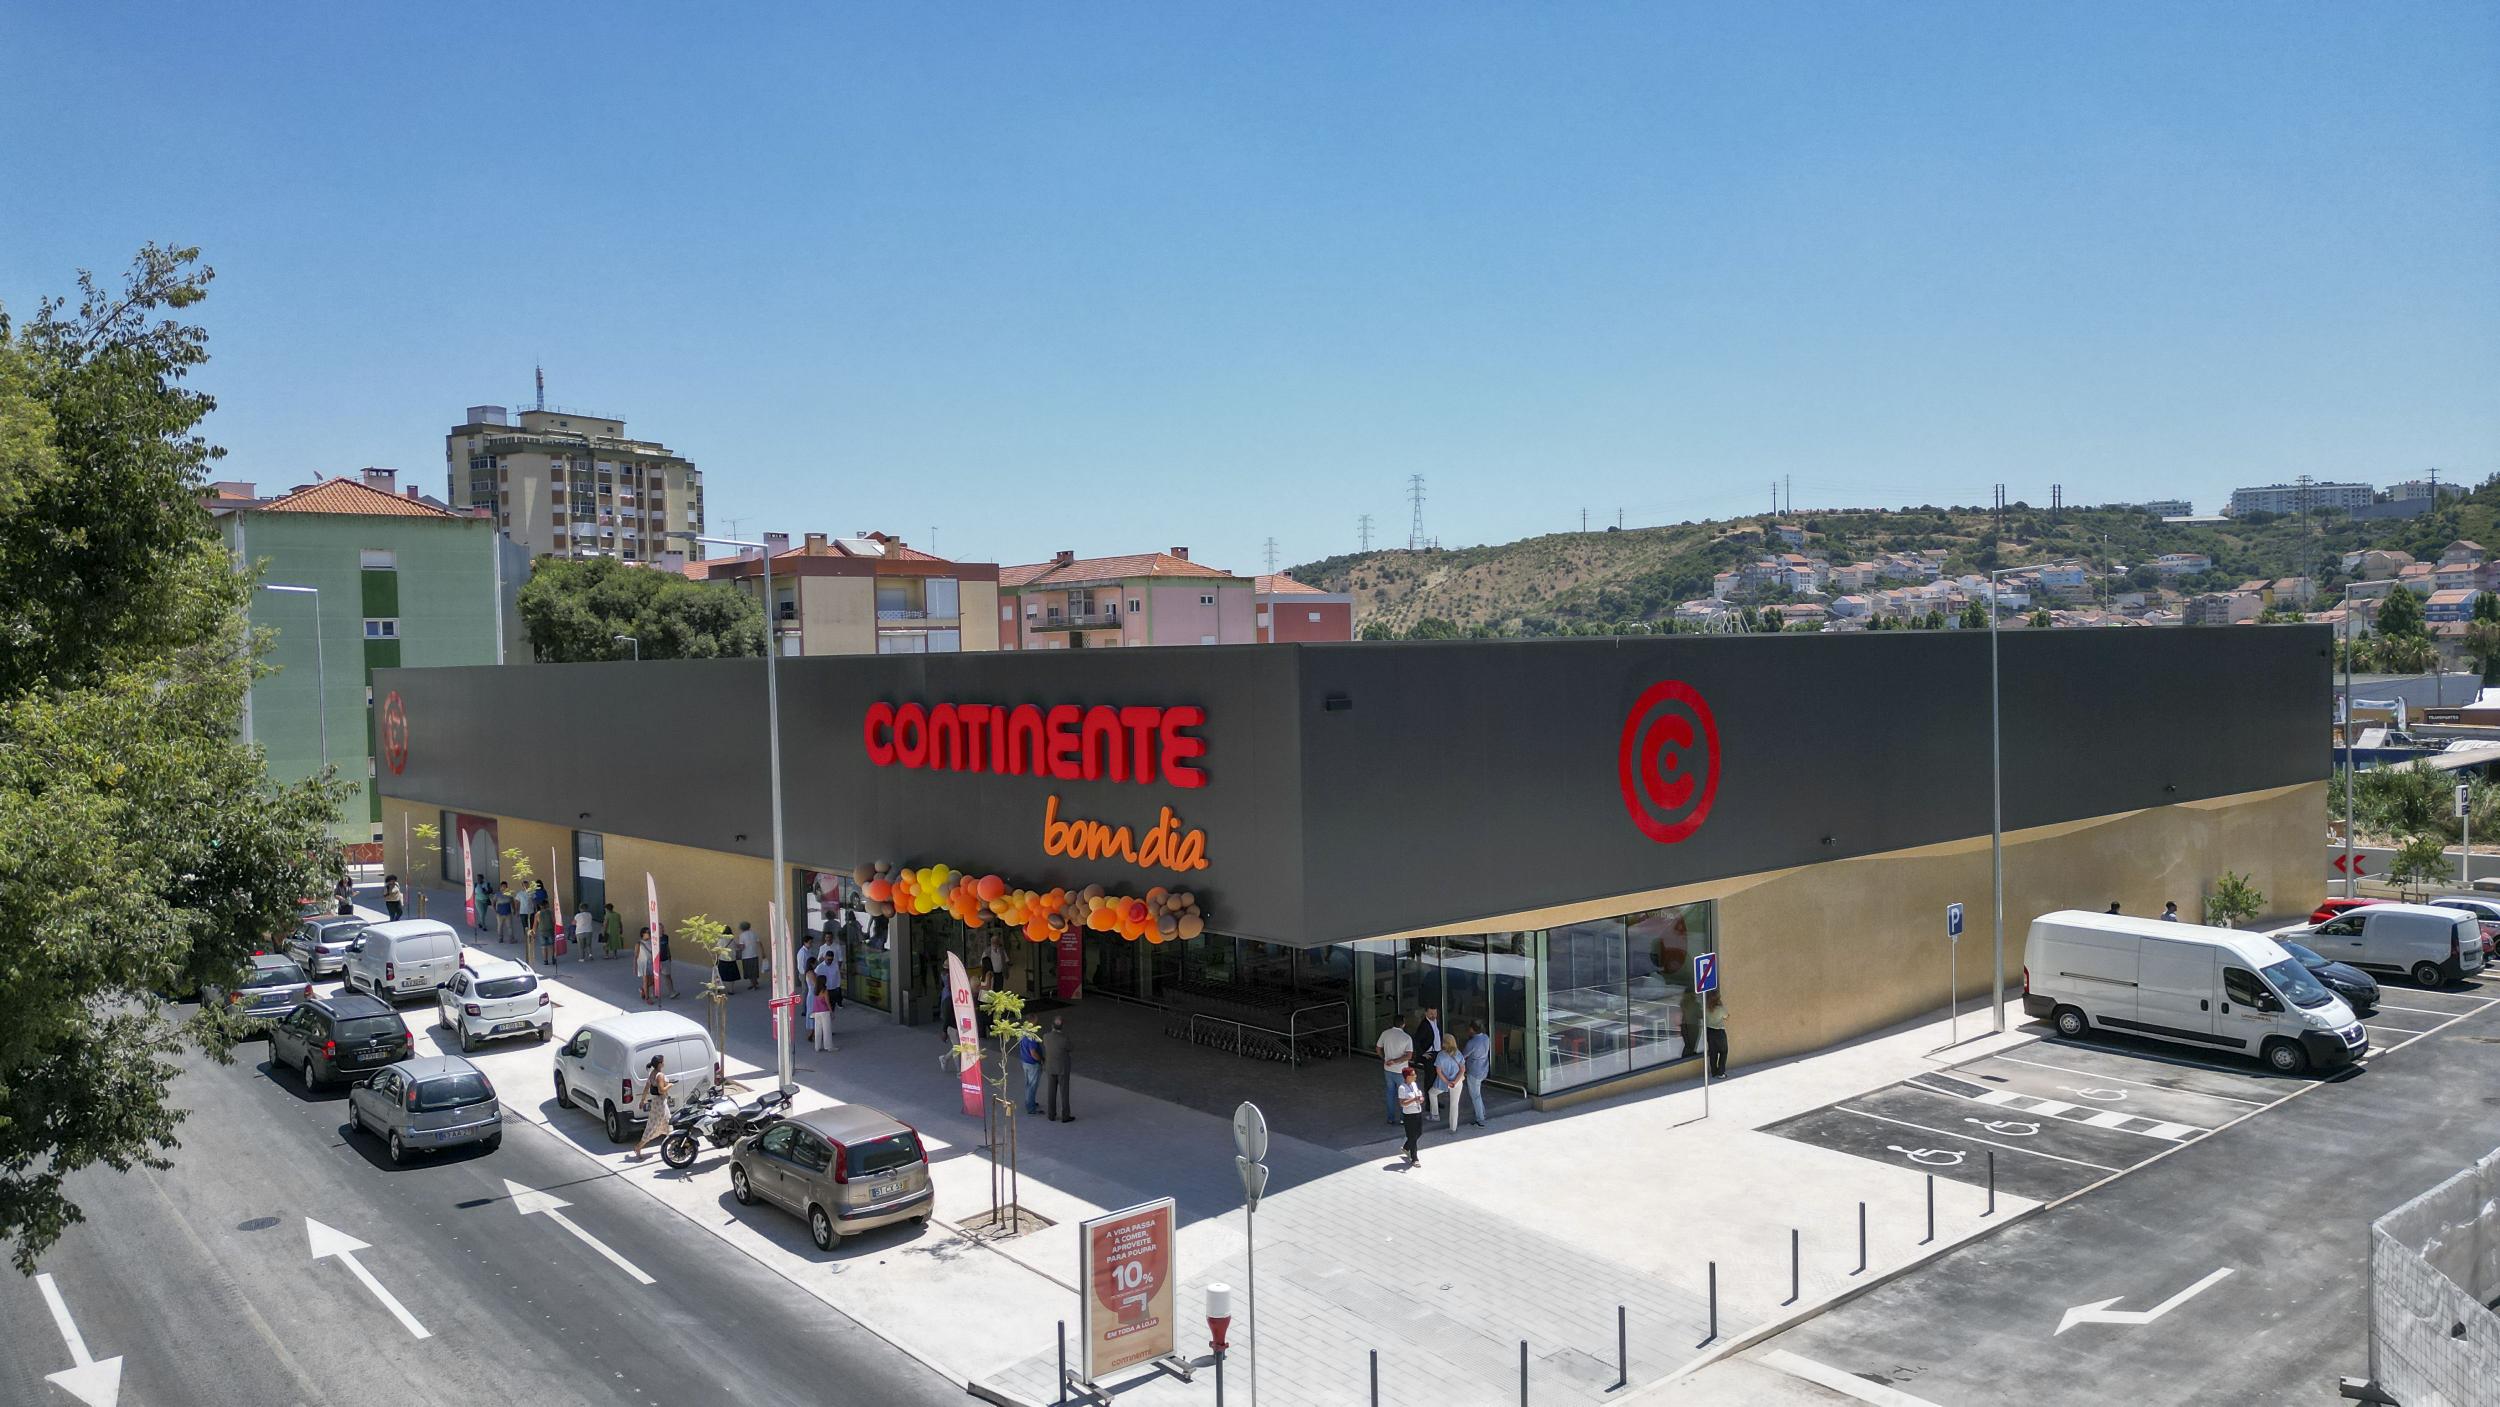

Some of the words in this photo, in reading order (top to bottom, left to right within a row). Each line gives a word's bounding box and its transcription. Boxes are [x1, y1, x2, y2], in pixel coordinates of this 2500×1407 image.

[864, 701, 1208, 789] CONTINENTE
[1043, 794, 1138, 862] bom
[1138, 805, 1212, 872] dia
[1951, 907, 1960, 933] P
[1106, 1231, 1112, 1239] A
[1113, 1226, 1131, 1237] VIDA
[1131, 1219, 1156, 1232] PASSA
[1112, 1238, 1152, 1254] APROVEITE
[1114, 1237, 1120, 1245] A
[1106, 1252, 1127, 1264] PARA
[1127, 1244, 1157, 1258] POUPAR
[1112, 1260, 1153, 1290] 10%
[1106, 1330, 1118, 1340] EM
[1117, 1325, 1135, 1336] TODA
[1135, 1323, 1141, 1331] A
[1141, 1318, 1157, 1329] LOJA
[1111, 1350, 1153, 1367] CONTINENTE
